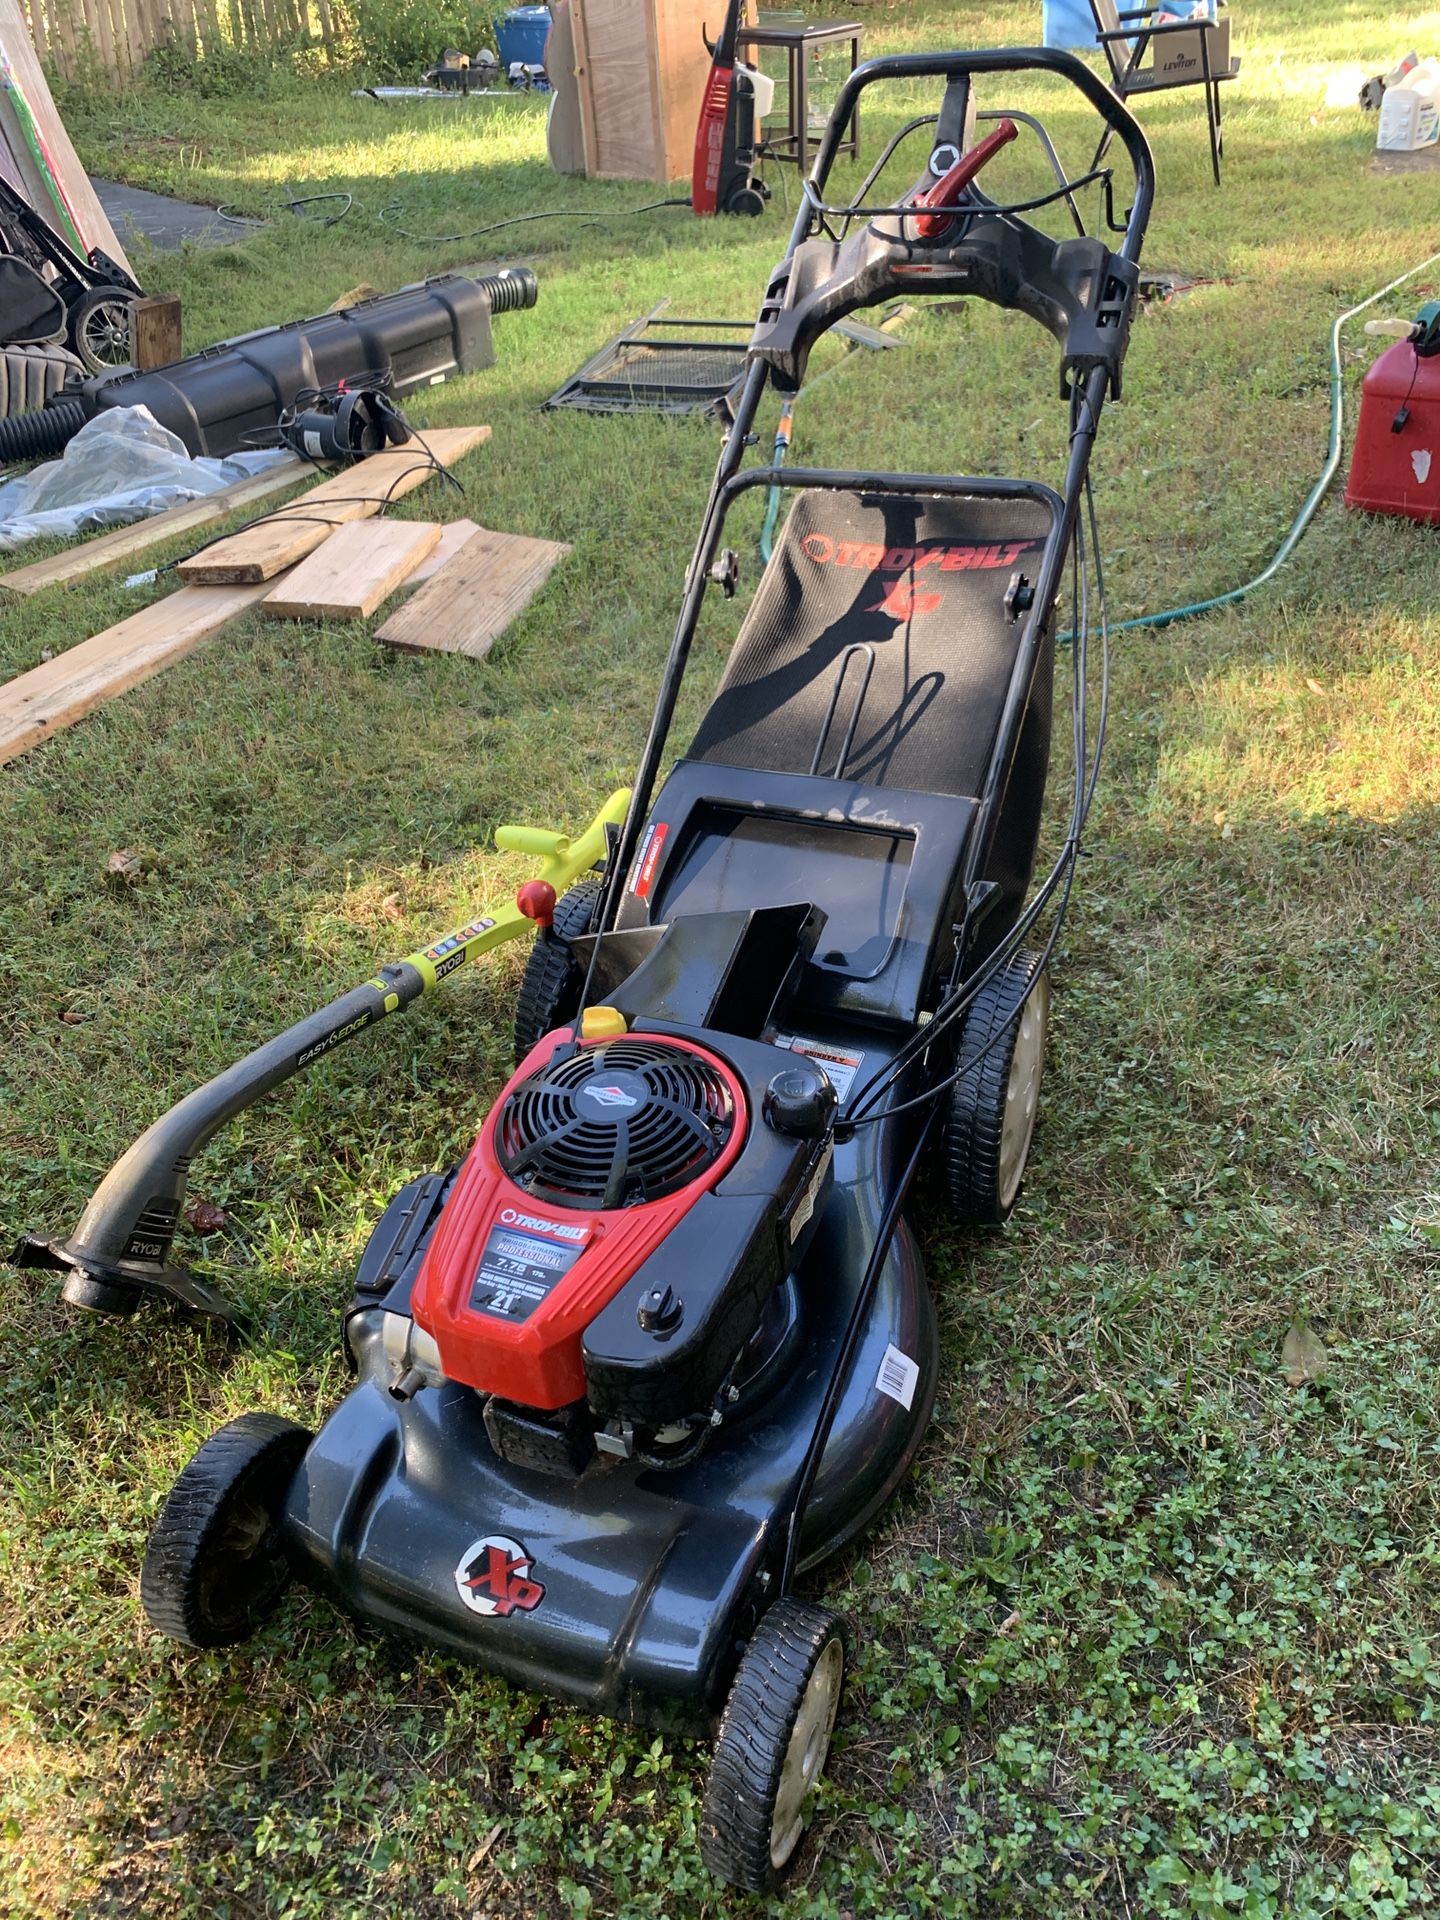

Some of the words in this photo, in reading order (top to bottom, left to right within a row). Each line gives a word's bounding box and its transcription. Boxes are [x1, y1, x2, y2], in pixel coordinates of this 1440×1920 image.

[834, 541, 1033, 572] TROY-BILT
[435, 951, 465, 981] RYOBI
[297, 1040, 328, 1066] EASY
[338, 1013, 369, 1039] EDGE
[514, 1213, 589, 1240] TROY-BILT
[130, 1240, 162, 1256] RYOBI
[497, 1242, 561, 1267] PROFESSIONAL
[496, 1257, 527, 1273] 7.75
